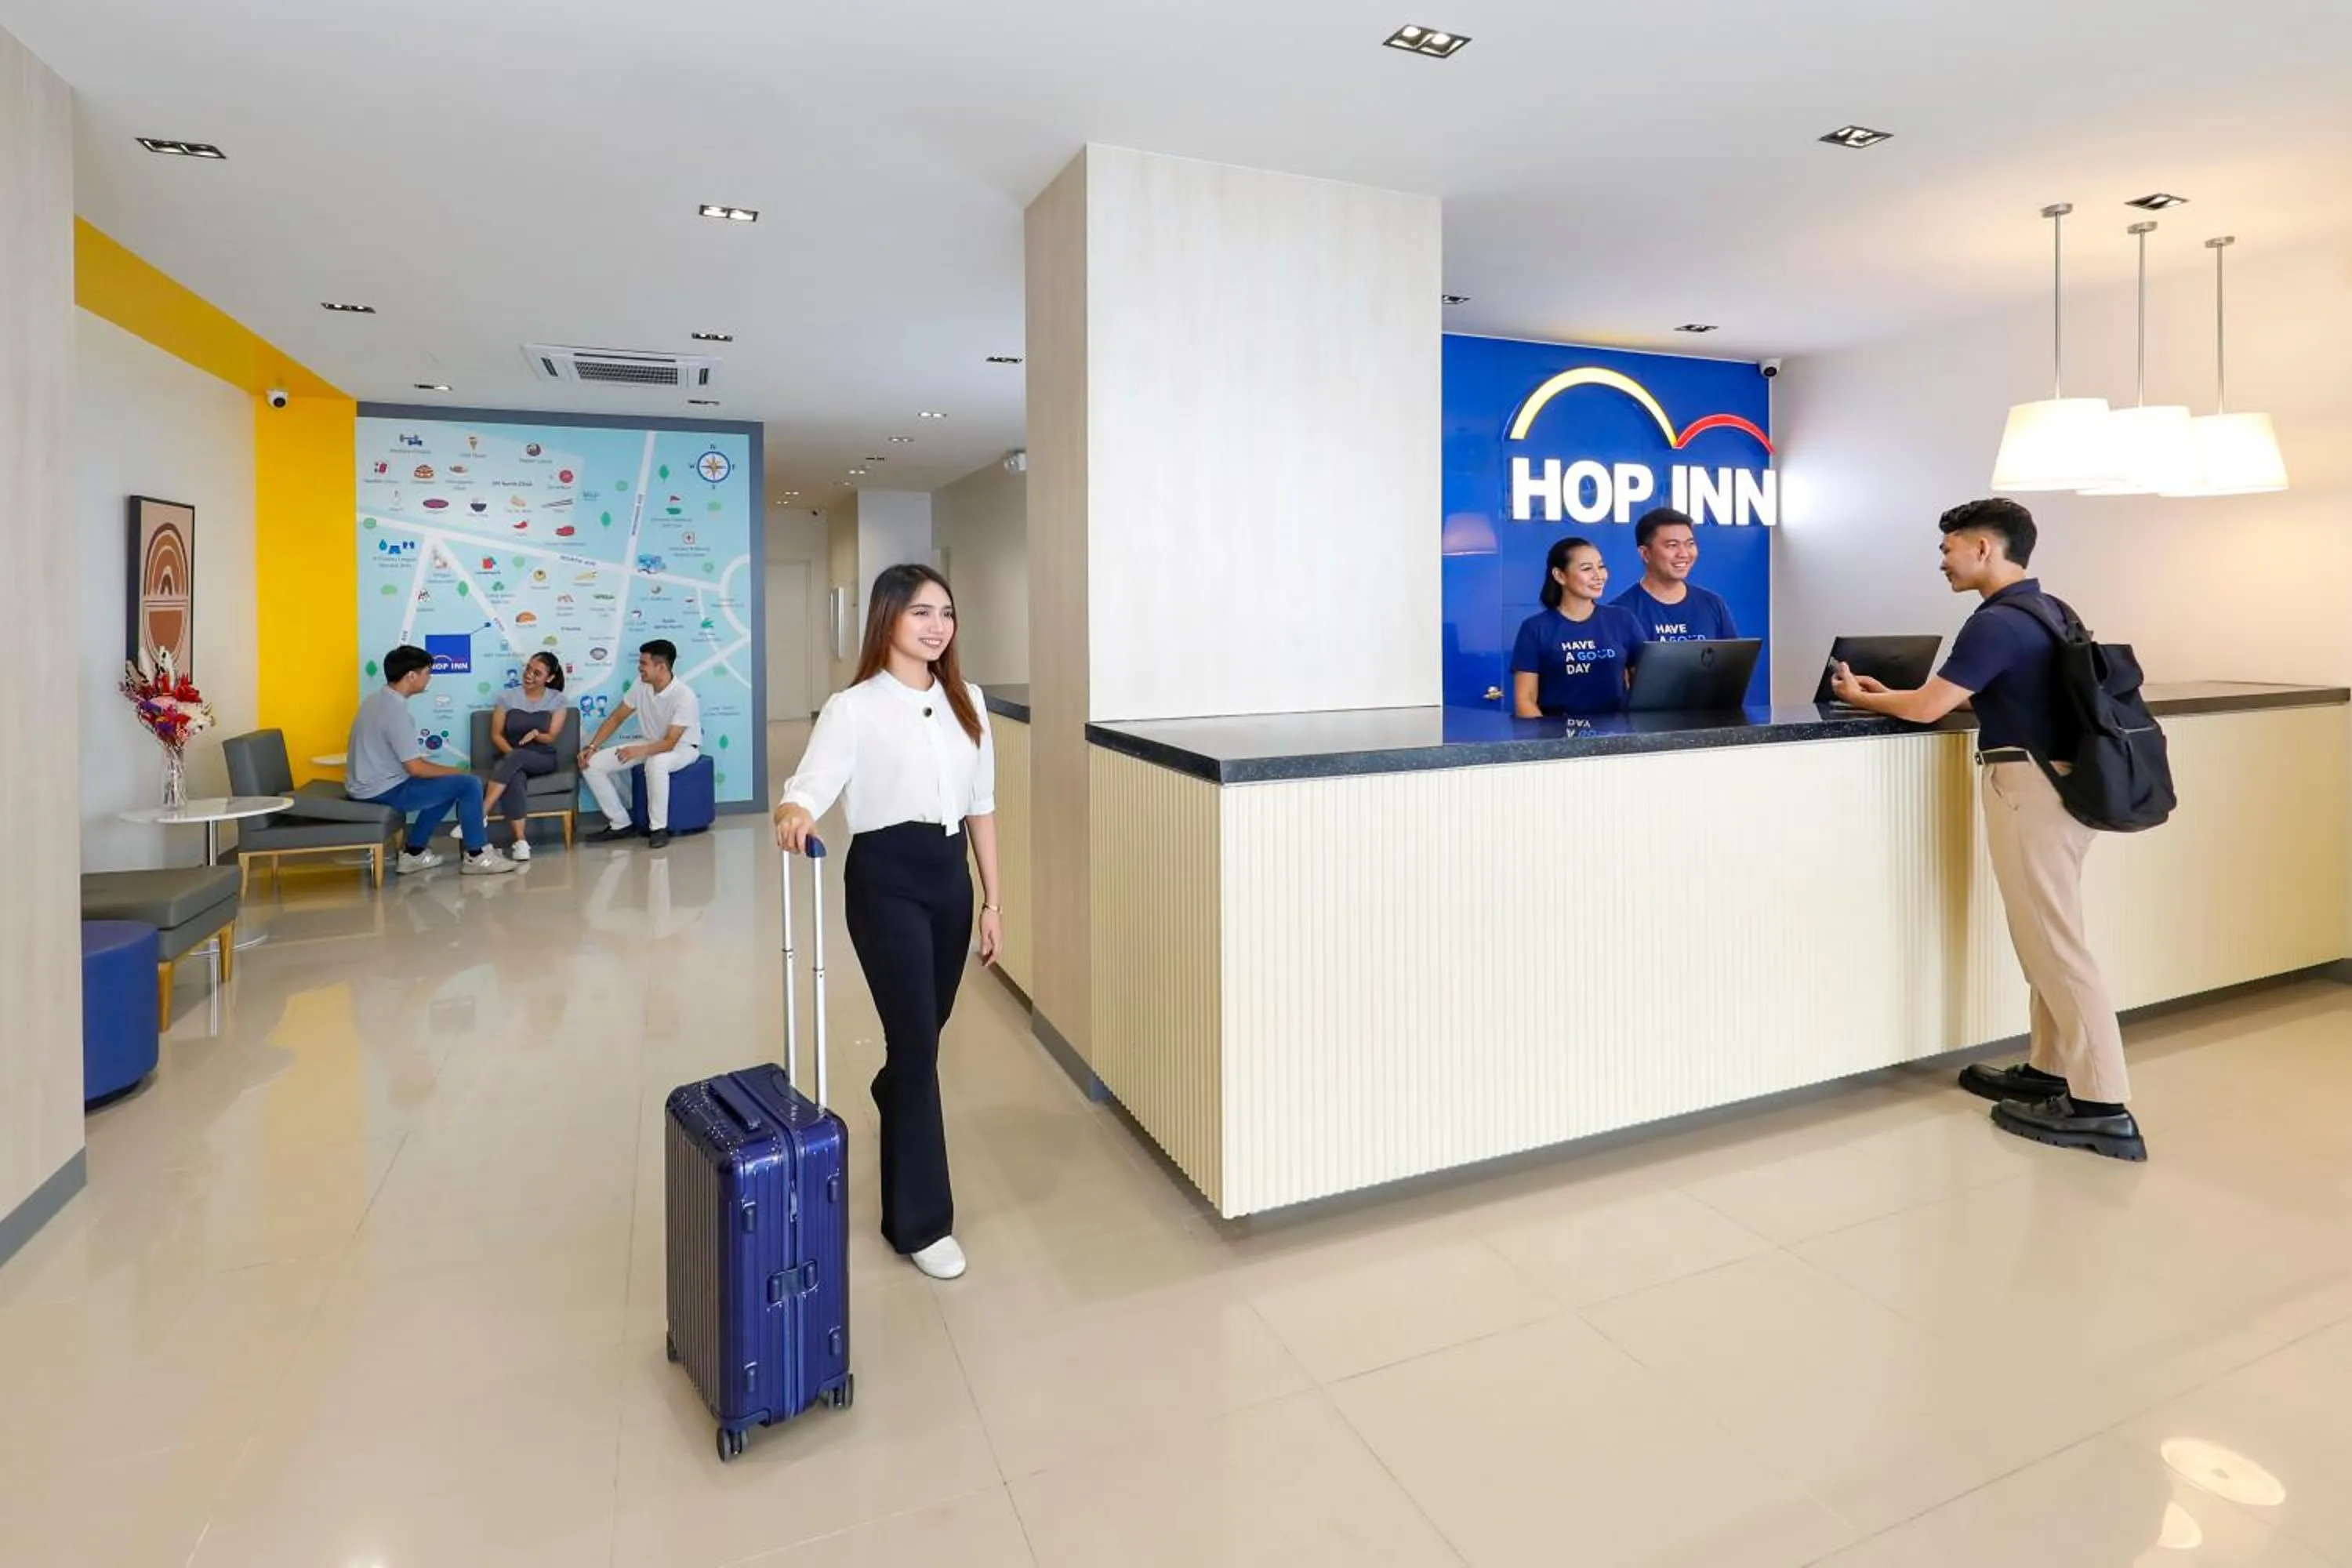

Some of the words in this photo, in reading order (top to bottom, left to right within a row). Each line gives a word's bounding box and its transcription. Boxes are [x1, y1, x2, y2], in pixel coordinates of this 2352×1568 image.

[1512, 457, 1654, 524] HOP
[1671, 464, 1777, 526] INN
[1655, 623, 1688, 634] HAVE
[1561, 640, 1596, 652] HAVE
[1566, 652, 1575, 662] A
[1566, 662, 1591, 674] DAY
